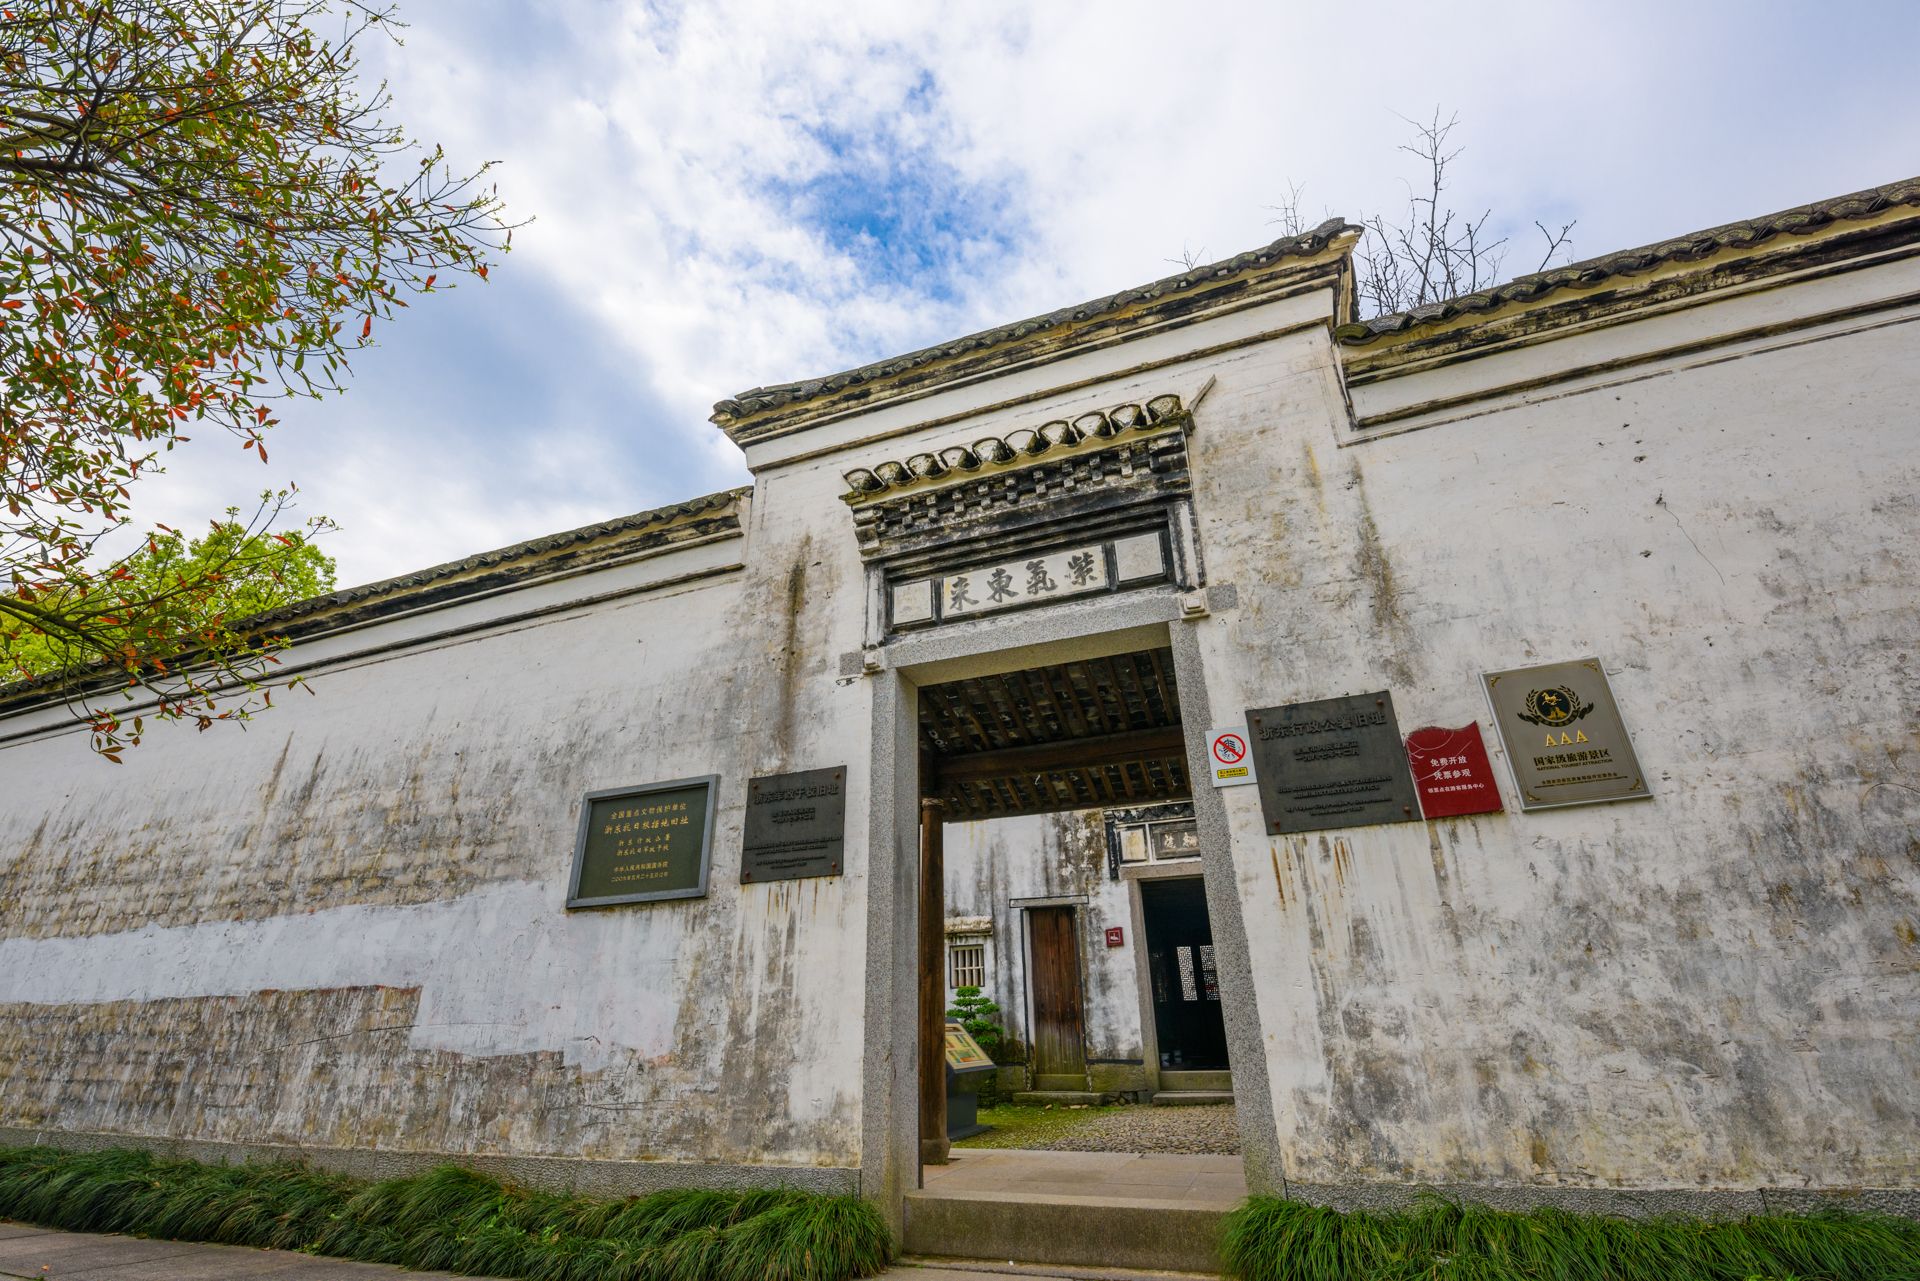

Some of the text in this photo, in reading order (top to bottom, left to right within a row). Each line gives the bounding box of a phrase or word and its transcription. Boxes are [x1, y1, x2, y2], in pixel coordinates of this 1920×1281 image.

[1545, 729, 1589, 747] AAA
[1430, 755, 1467, 767] 免费开放
[1533, 748, 1611, 766] 国家级旅游景区
